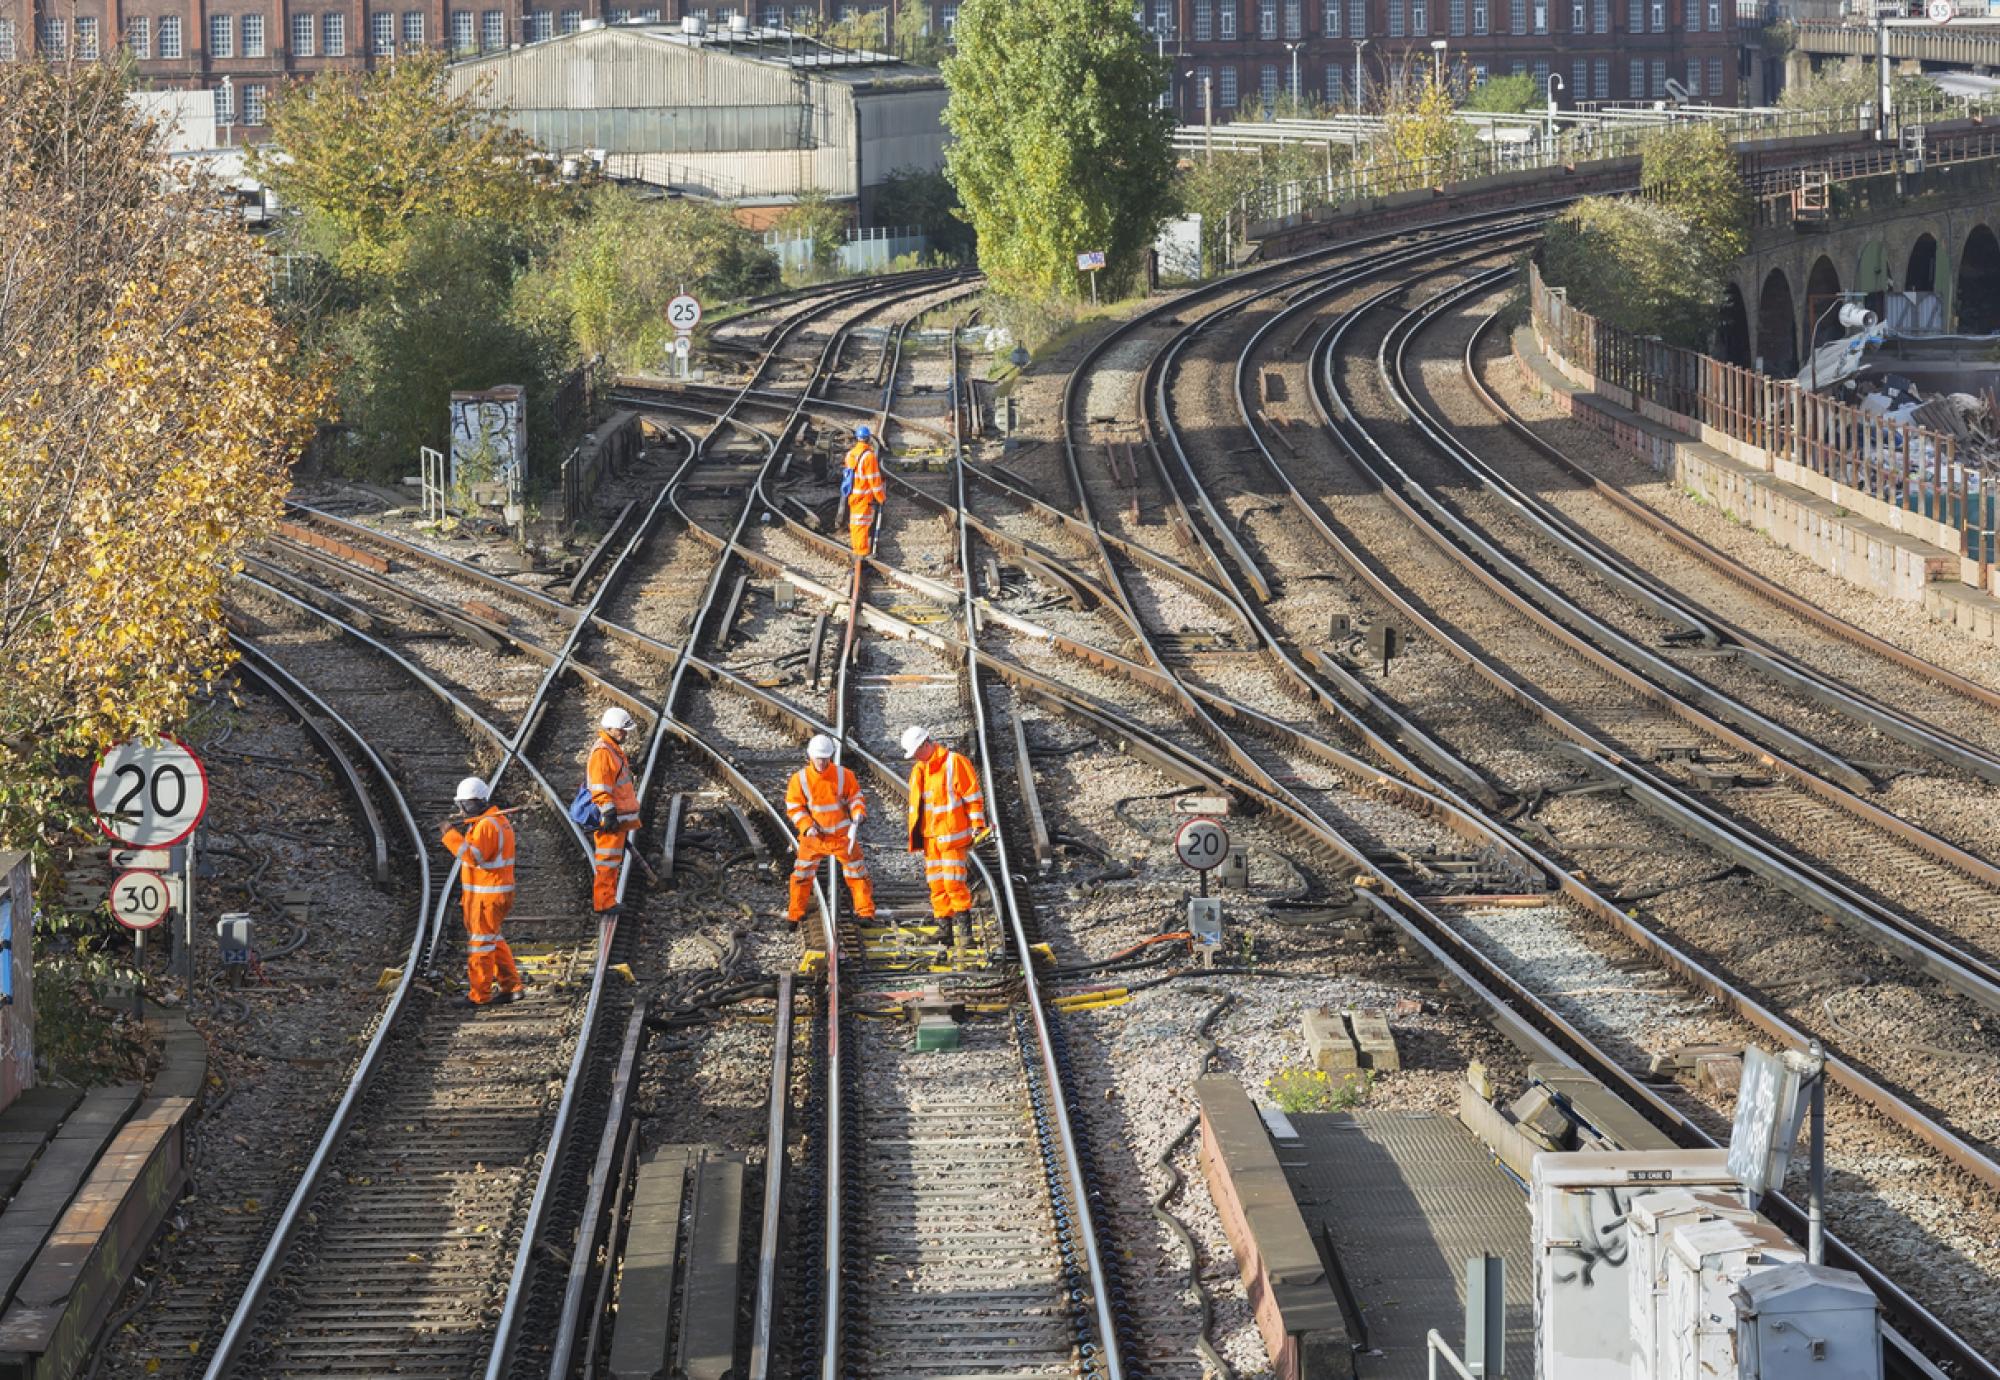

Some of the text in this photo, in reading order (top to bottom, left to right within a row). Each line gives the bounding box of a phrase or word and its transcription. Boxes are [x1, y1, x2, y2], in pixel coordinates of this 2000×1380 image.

[674, 304, 696, 321] 25
[114, 763, 186, 818] 20
[1187, 832, 1219, 856] 20
[122, 885, 159, 914] 30
